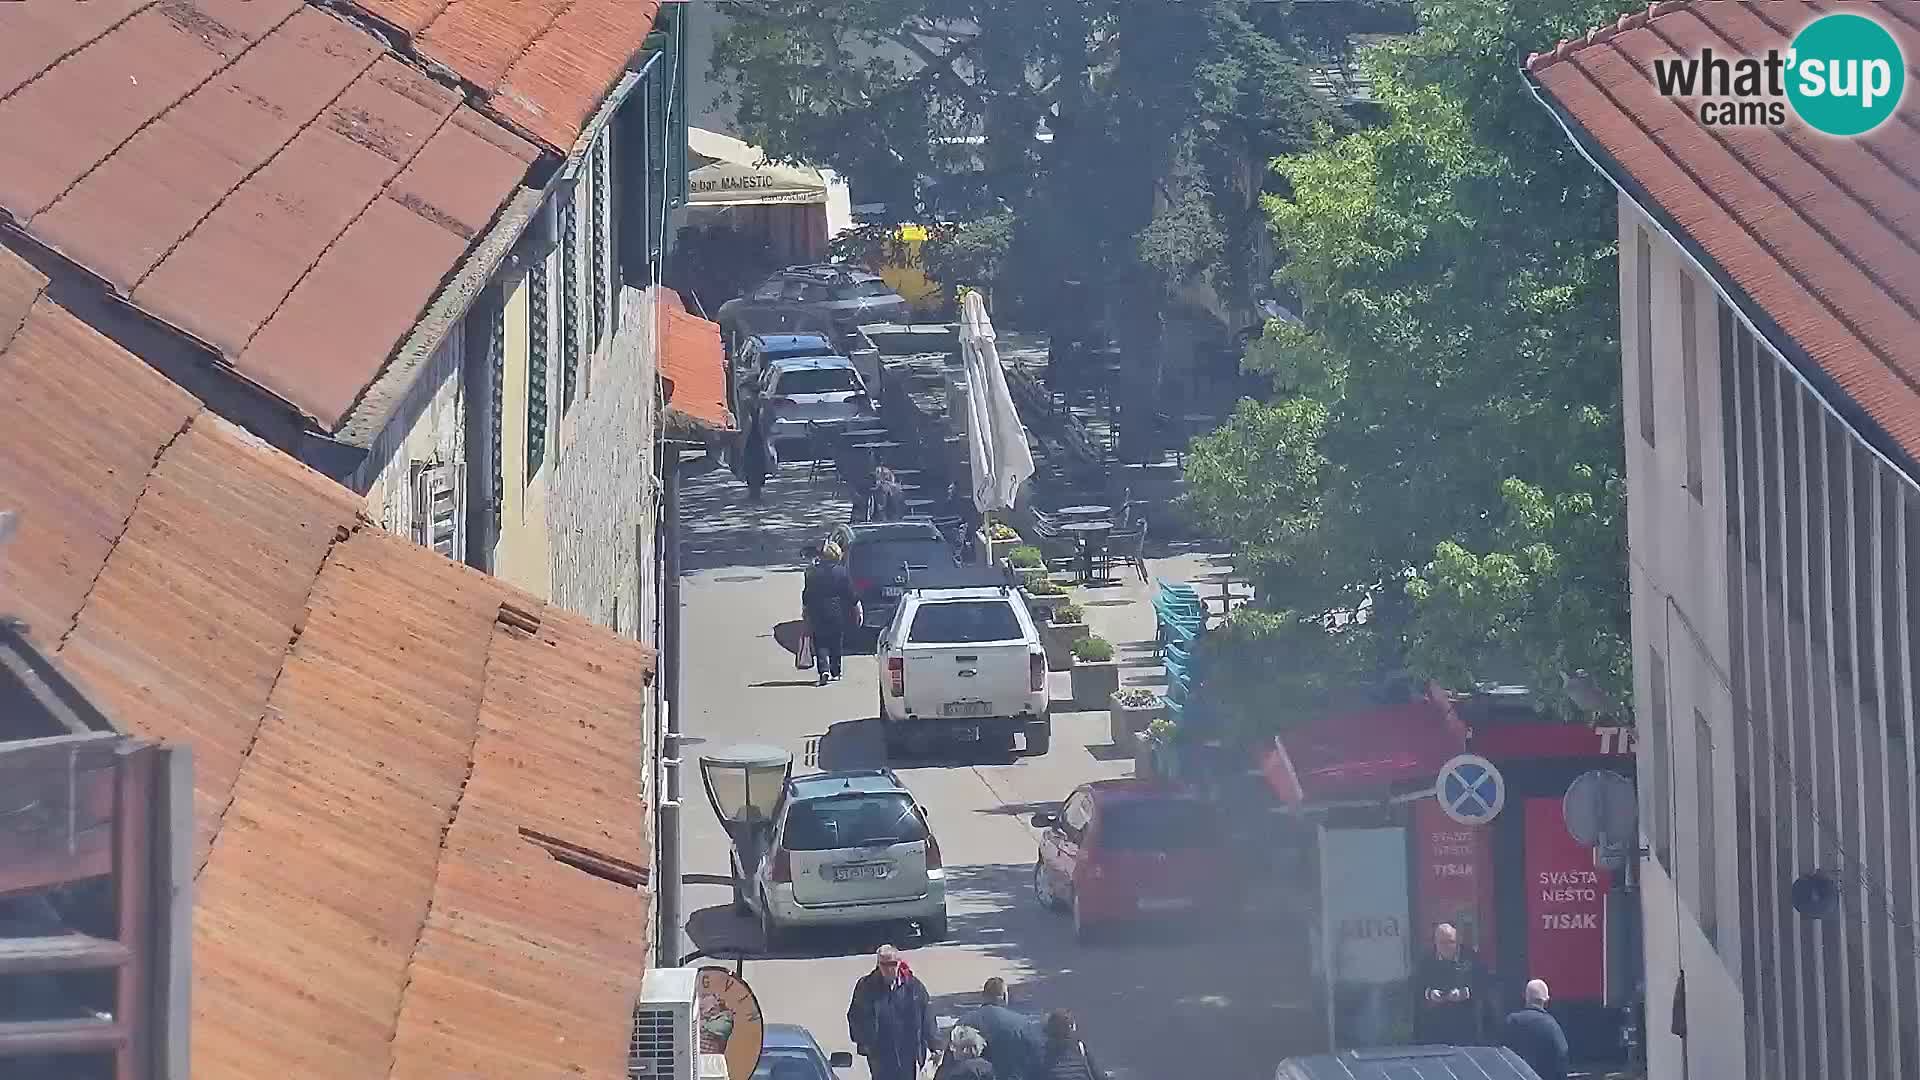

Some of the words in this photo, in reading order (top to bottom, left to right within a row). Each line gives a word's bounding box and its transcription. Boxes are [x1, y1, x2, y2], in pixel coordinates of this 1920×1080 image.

[700, 179, 717, 191] bar
[721, 175, 773, 189] MAJESTIC
[1539, 869, 1598, 884] SVAŠTA
[1542, 887, 1596, 901] NEŠTO
[1542, 913, 1597, 929] TISAK
